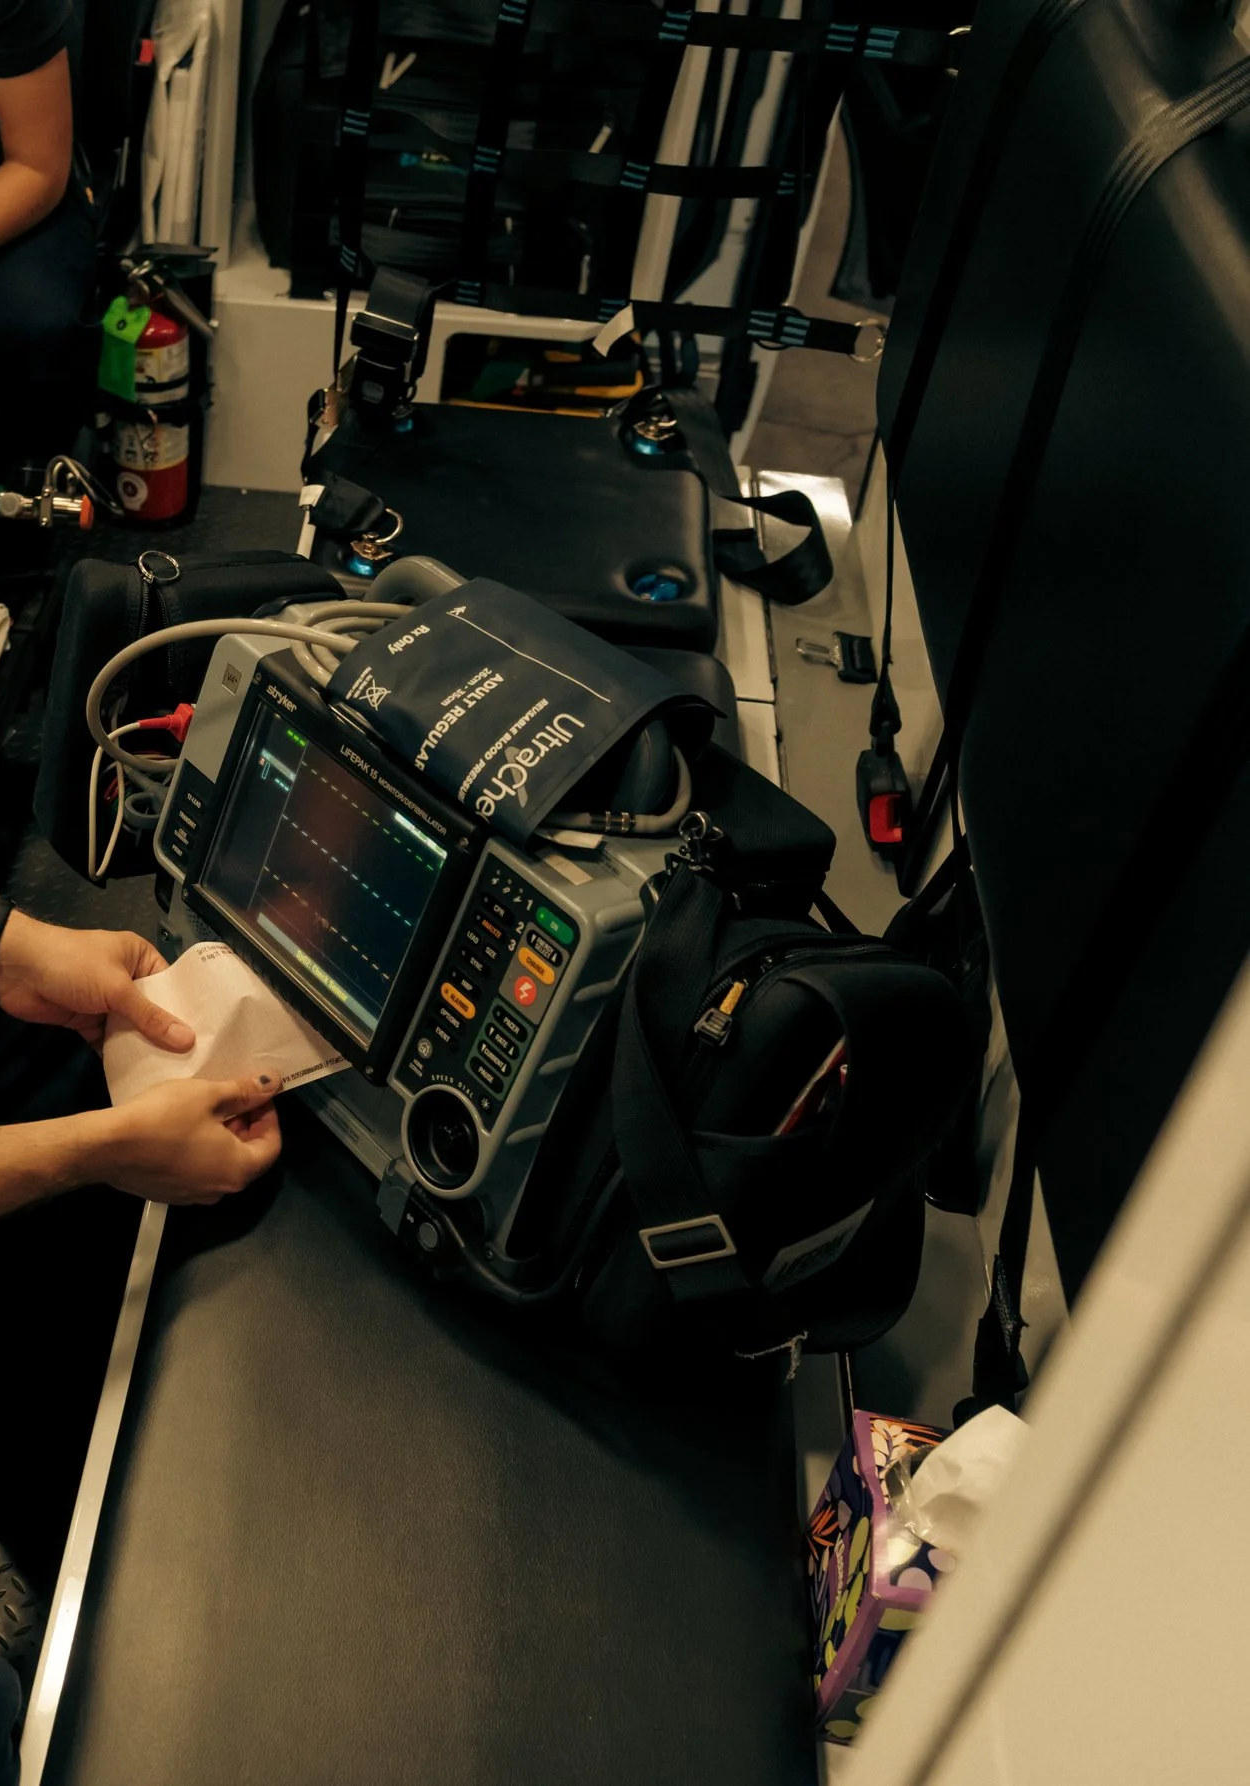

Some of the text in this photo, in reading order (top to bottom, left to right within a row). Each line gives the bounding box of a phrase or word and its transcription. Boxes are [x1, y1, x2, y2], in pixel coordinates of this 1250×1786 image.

[387, 624, 431, 654] Rx Only
[265, 684, 298, 712] stryker
[414, 672, 505, 772] ADULT REGULAR
[508, 697, 549, 735] REUSABLE
[482, 731, 512, 761] BLOOD
[475, 713, 586, 822] UltraChe
[338, 743, 448, 836] LIFEPAK 15 MONITOR/DEFIBRILLATOR
[493, 903, 505, 918] CPR
[526, 899, 534, 911] 1
[467, 930, 480, 945] LEAD
[515, 921, 525, 934] 2
[507, 938, 517, 952] 3
[435, 1026, 451, 1043] EVENT
[503, 1017, 520, 1035] PACER
